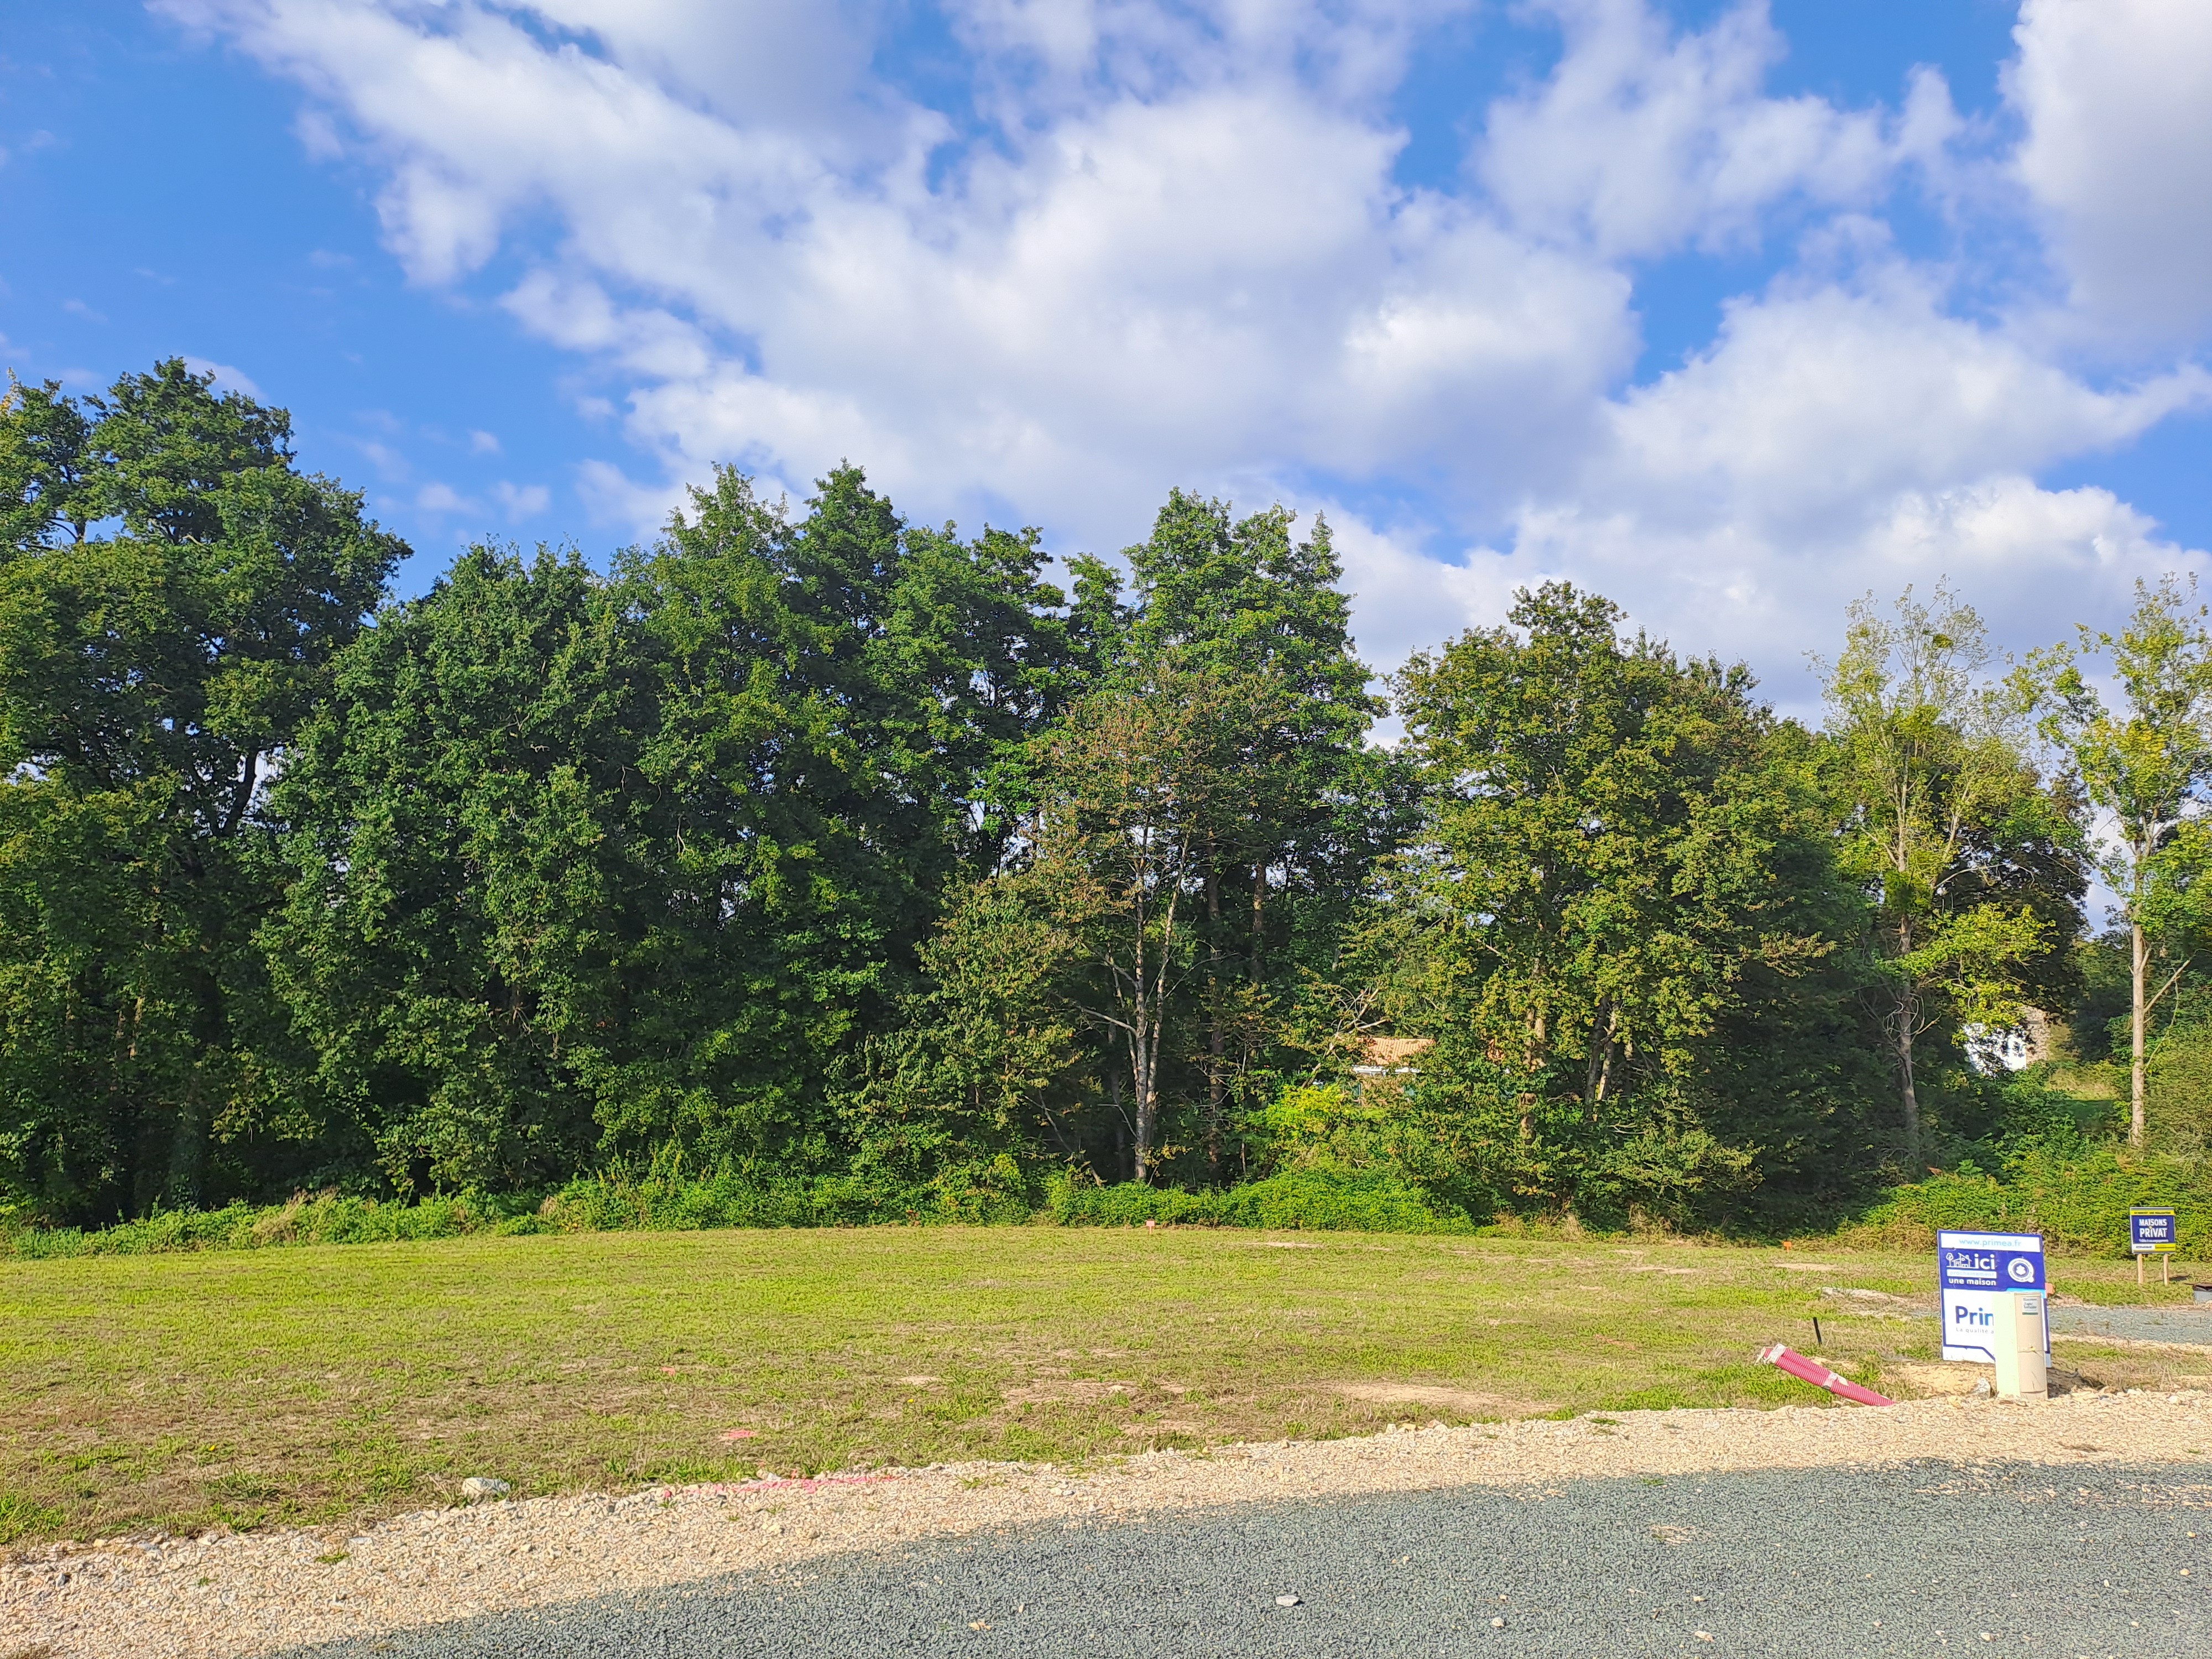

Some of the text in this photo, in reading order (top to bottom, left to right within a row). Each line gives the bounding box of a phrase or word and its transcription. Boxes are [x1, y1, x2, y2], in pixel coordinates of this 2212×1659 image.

[2140, 1228, 2168, 1238] PRIVAT
[1959, 1239, 2021, 1247] www.primea.fr
[1974, 1253, 1995, 1270] ici
